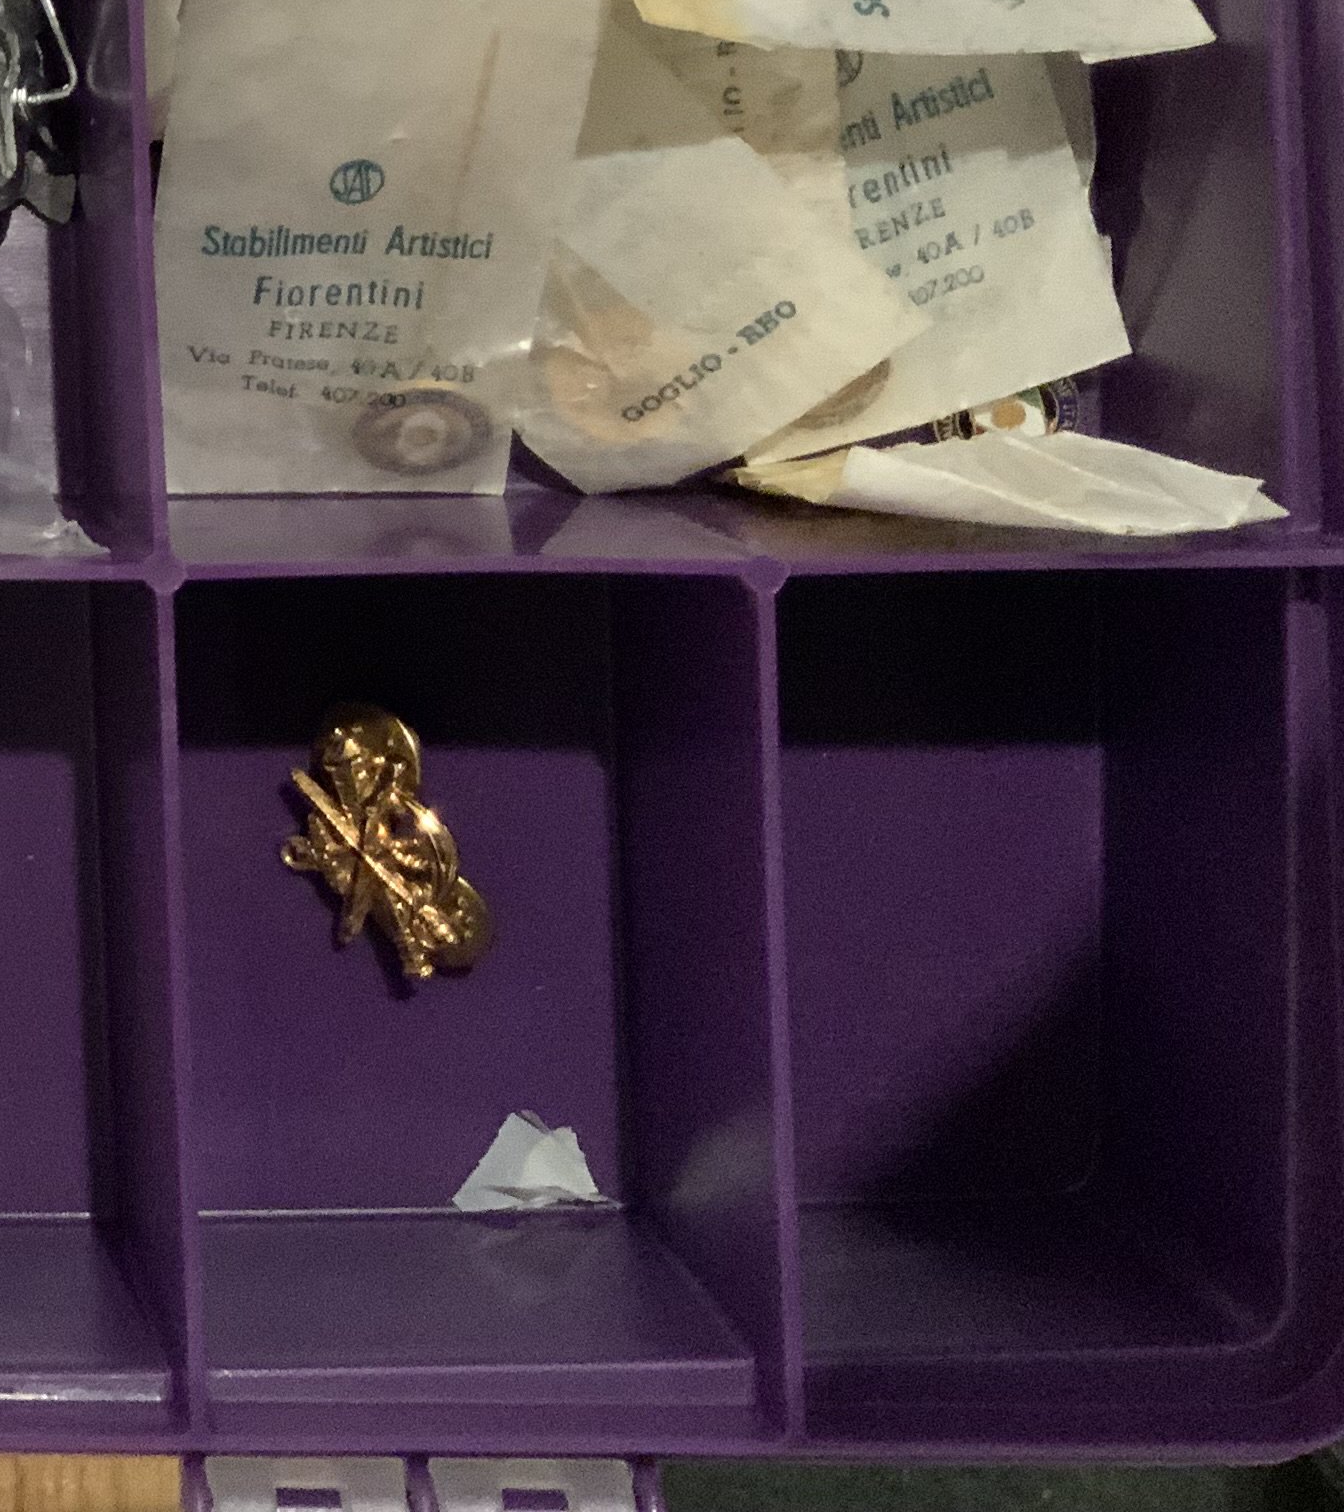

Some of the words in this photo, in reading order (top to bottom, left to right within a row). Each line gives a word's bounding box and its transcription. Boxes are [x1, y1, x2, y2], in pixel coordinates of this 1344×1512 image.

[890, 67, 995, 132] Artistici
[201, 224, 370, 258] Stabilimenti
[385, 224, 494, 260] Artistici
[253, 276, 425, 310] Fiorentini
[268, 319, 399, 345] FIRENZE
[187, 345, 231, 365] Via
